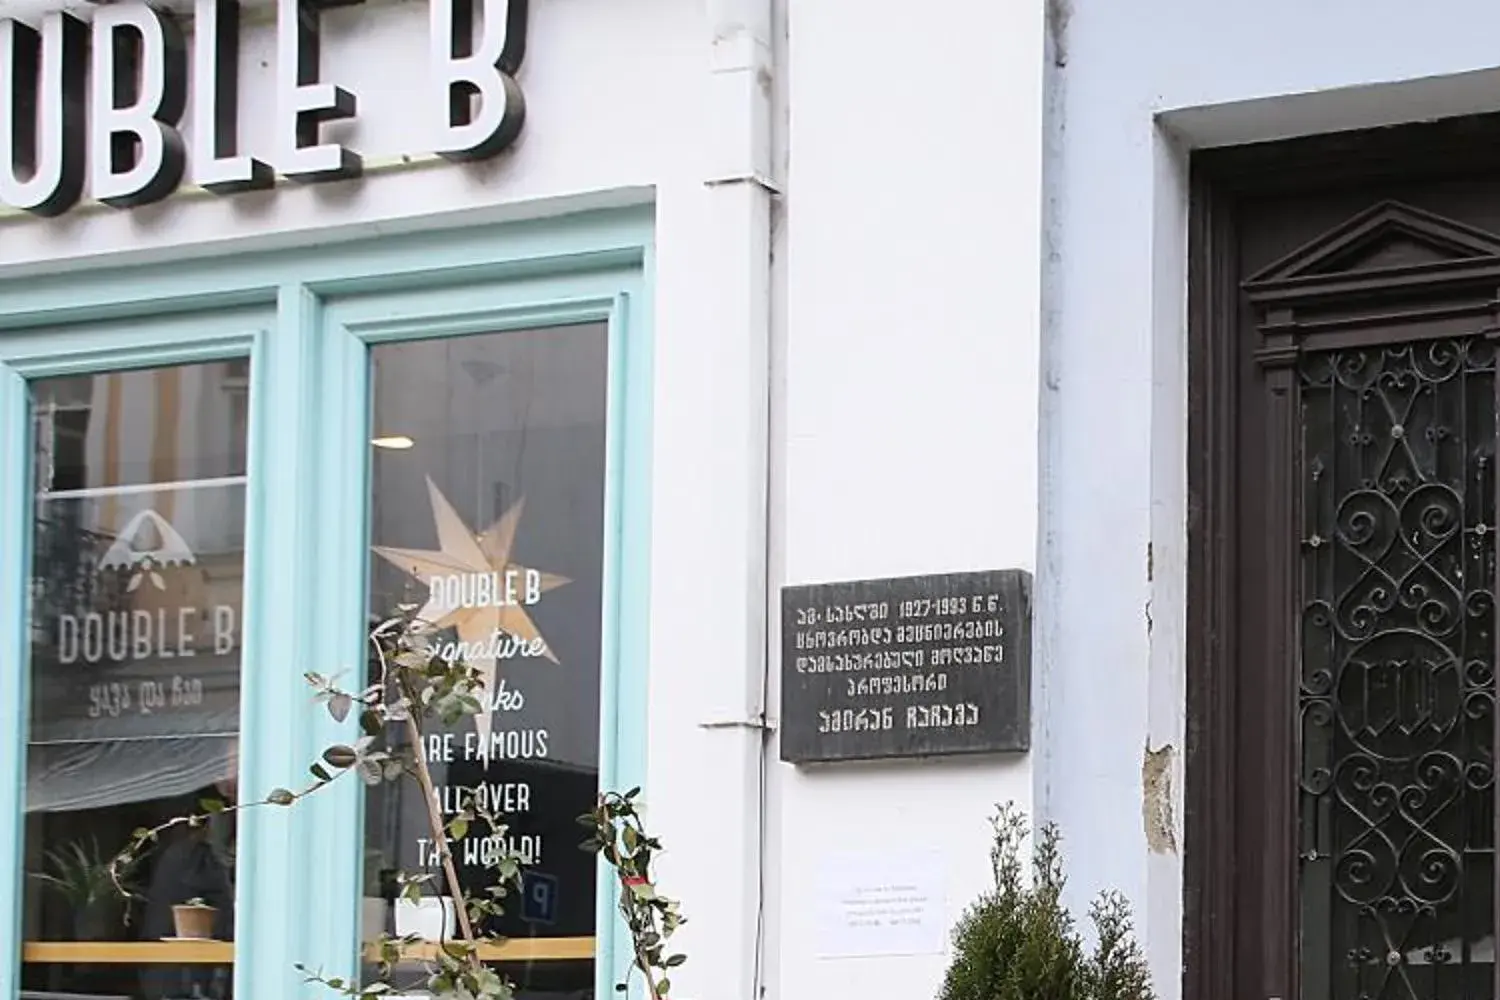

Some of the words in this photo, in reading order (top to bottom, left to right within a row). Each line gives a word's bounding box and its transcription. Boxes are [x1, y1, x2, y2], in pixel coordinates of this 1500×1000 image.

[430, 0, 526, 162] B
[429, 570, 518, 609] DOUBLE
[525, 568, 541, 605] B
[825, 602, 889, 624] სახლში
[58, 606, 197, 665] DOUBLE
[214, 604, 236, 656] B
[795, 626, 893, 650] ცხოვრობდა
[896, 619, 1004, 644] მეცნიერების
[930, 644, 1004, 667] მოღვაწე
[138, 680, 166, 715] და
[846, 672, 948, 698] პროფესორი
[817, 706, 894, 734] ამირან
[906, 702, 980, 730] ჩაჩავა
[465, 729, 549, 761] FAMOUS
[475, 781, 531, 813] OVER
[416, 837, 453, 868] TH
